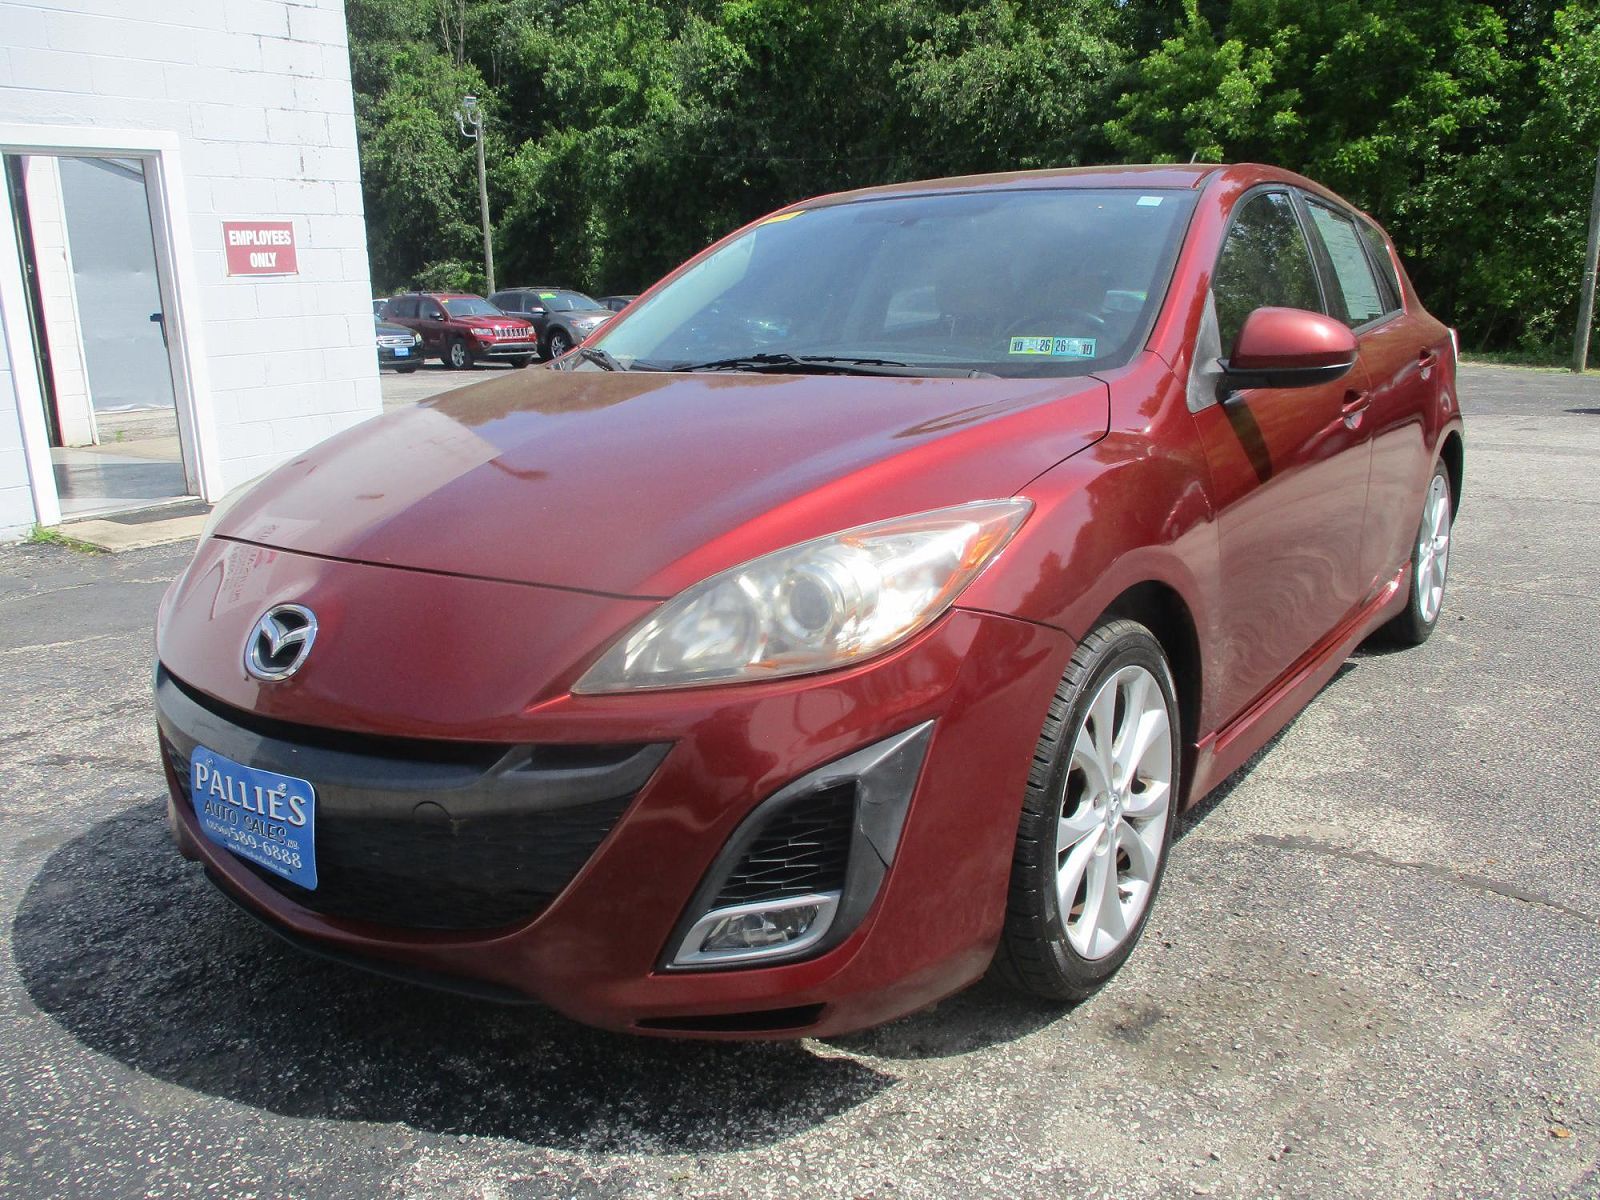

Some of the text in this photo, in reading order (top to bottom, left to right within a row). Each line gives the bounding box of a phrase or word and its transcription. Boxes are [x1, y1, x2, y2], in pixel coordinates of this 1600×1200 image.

[228, 229, 292, 246] EMPLOYEES
[249, 252, 277, 268] ONLY
[1039, 339, 1051, 352] 26
[1055, 339, 1066, 352] 26
[204, 799, 239, 826] AUTO
[243, 814, 287, 845] SALES
